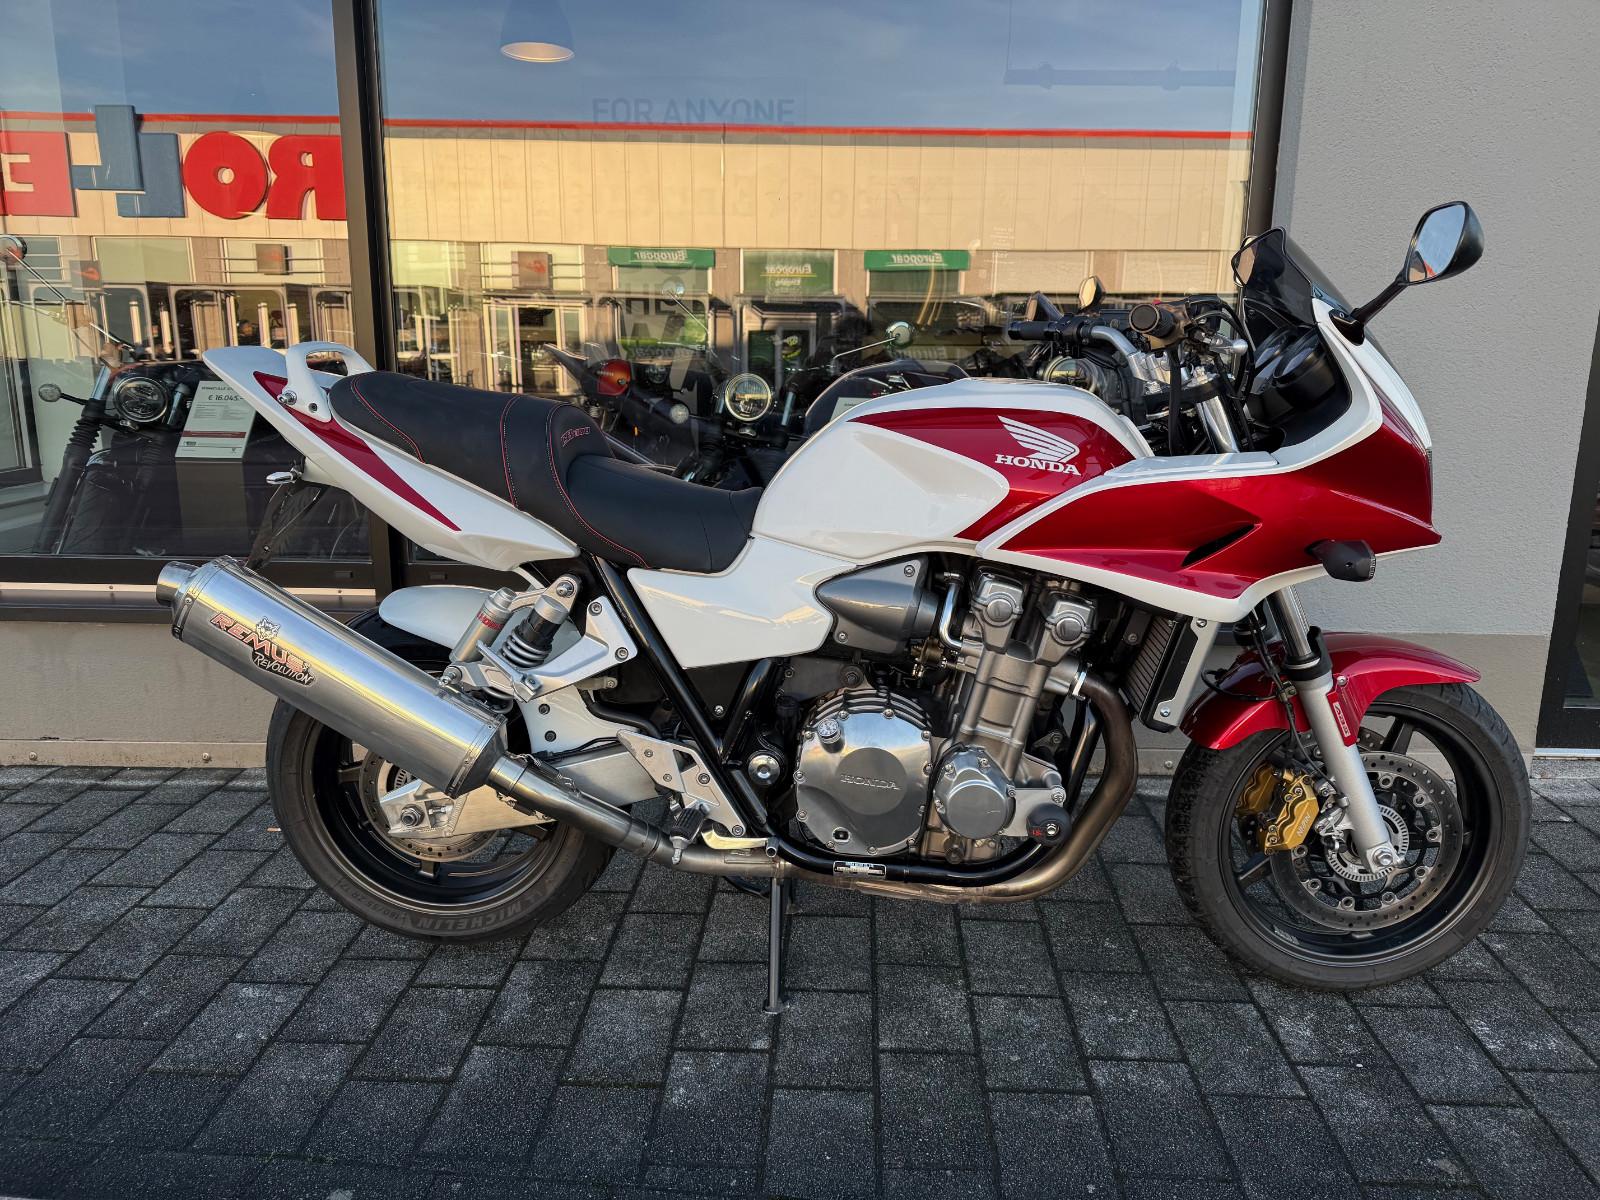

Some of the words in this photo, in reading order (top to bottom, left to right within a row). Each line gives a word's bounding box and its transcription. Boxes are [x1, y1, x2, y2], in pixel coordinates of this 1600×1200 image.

[592, 98, 655, 125] FOR
[662, 98, 796, 126] ANYONE
[995, 453, 1081, 476] HONDA
[210, 611, 305, 673] REMUS
[840, 774, 901, 790] HONDA
[416, 900, 524, 931] MICHELIN
